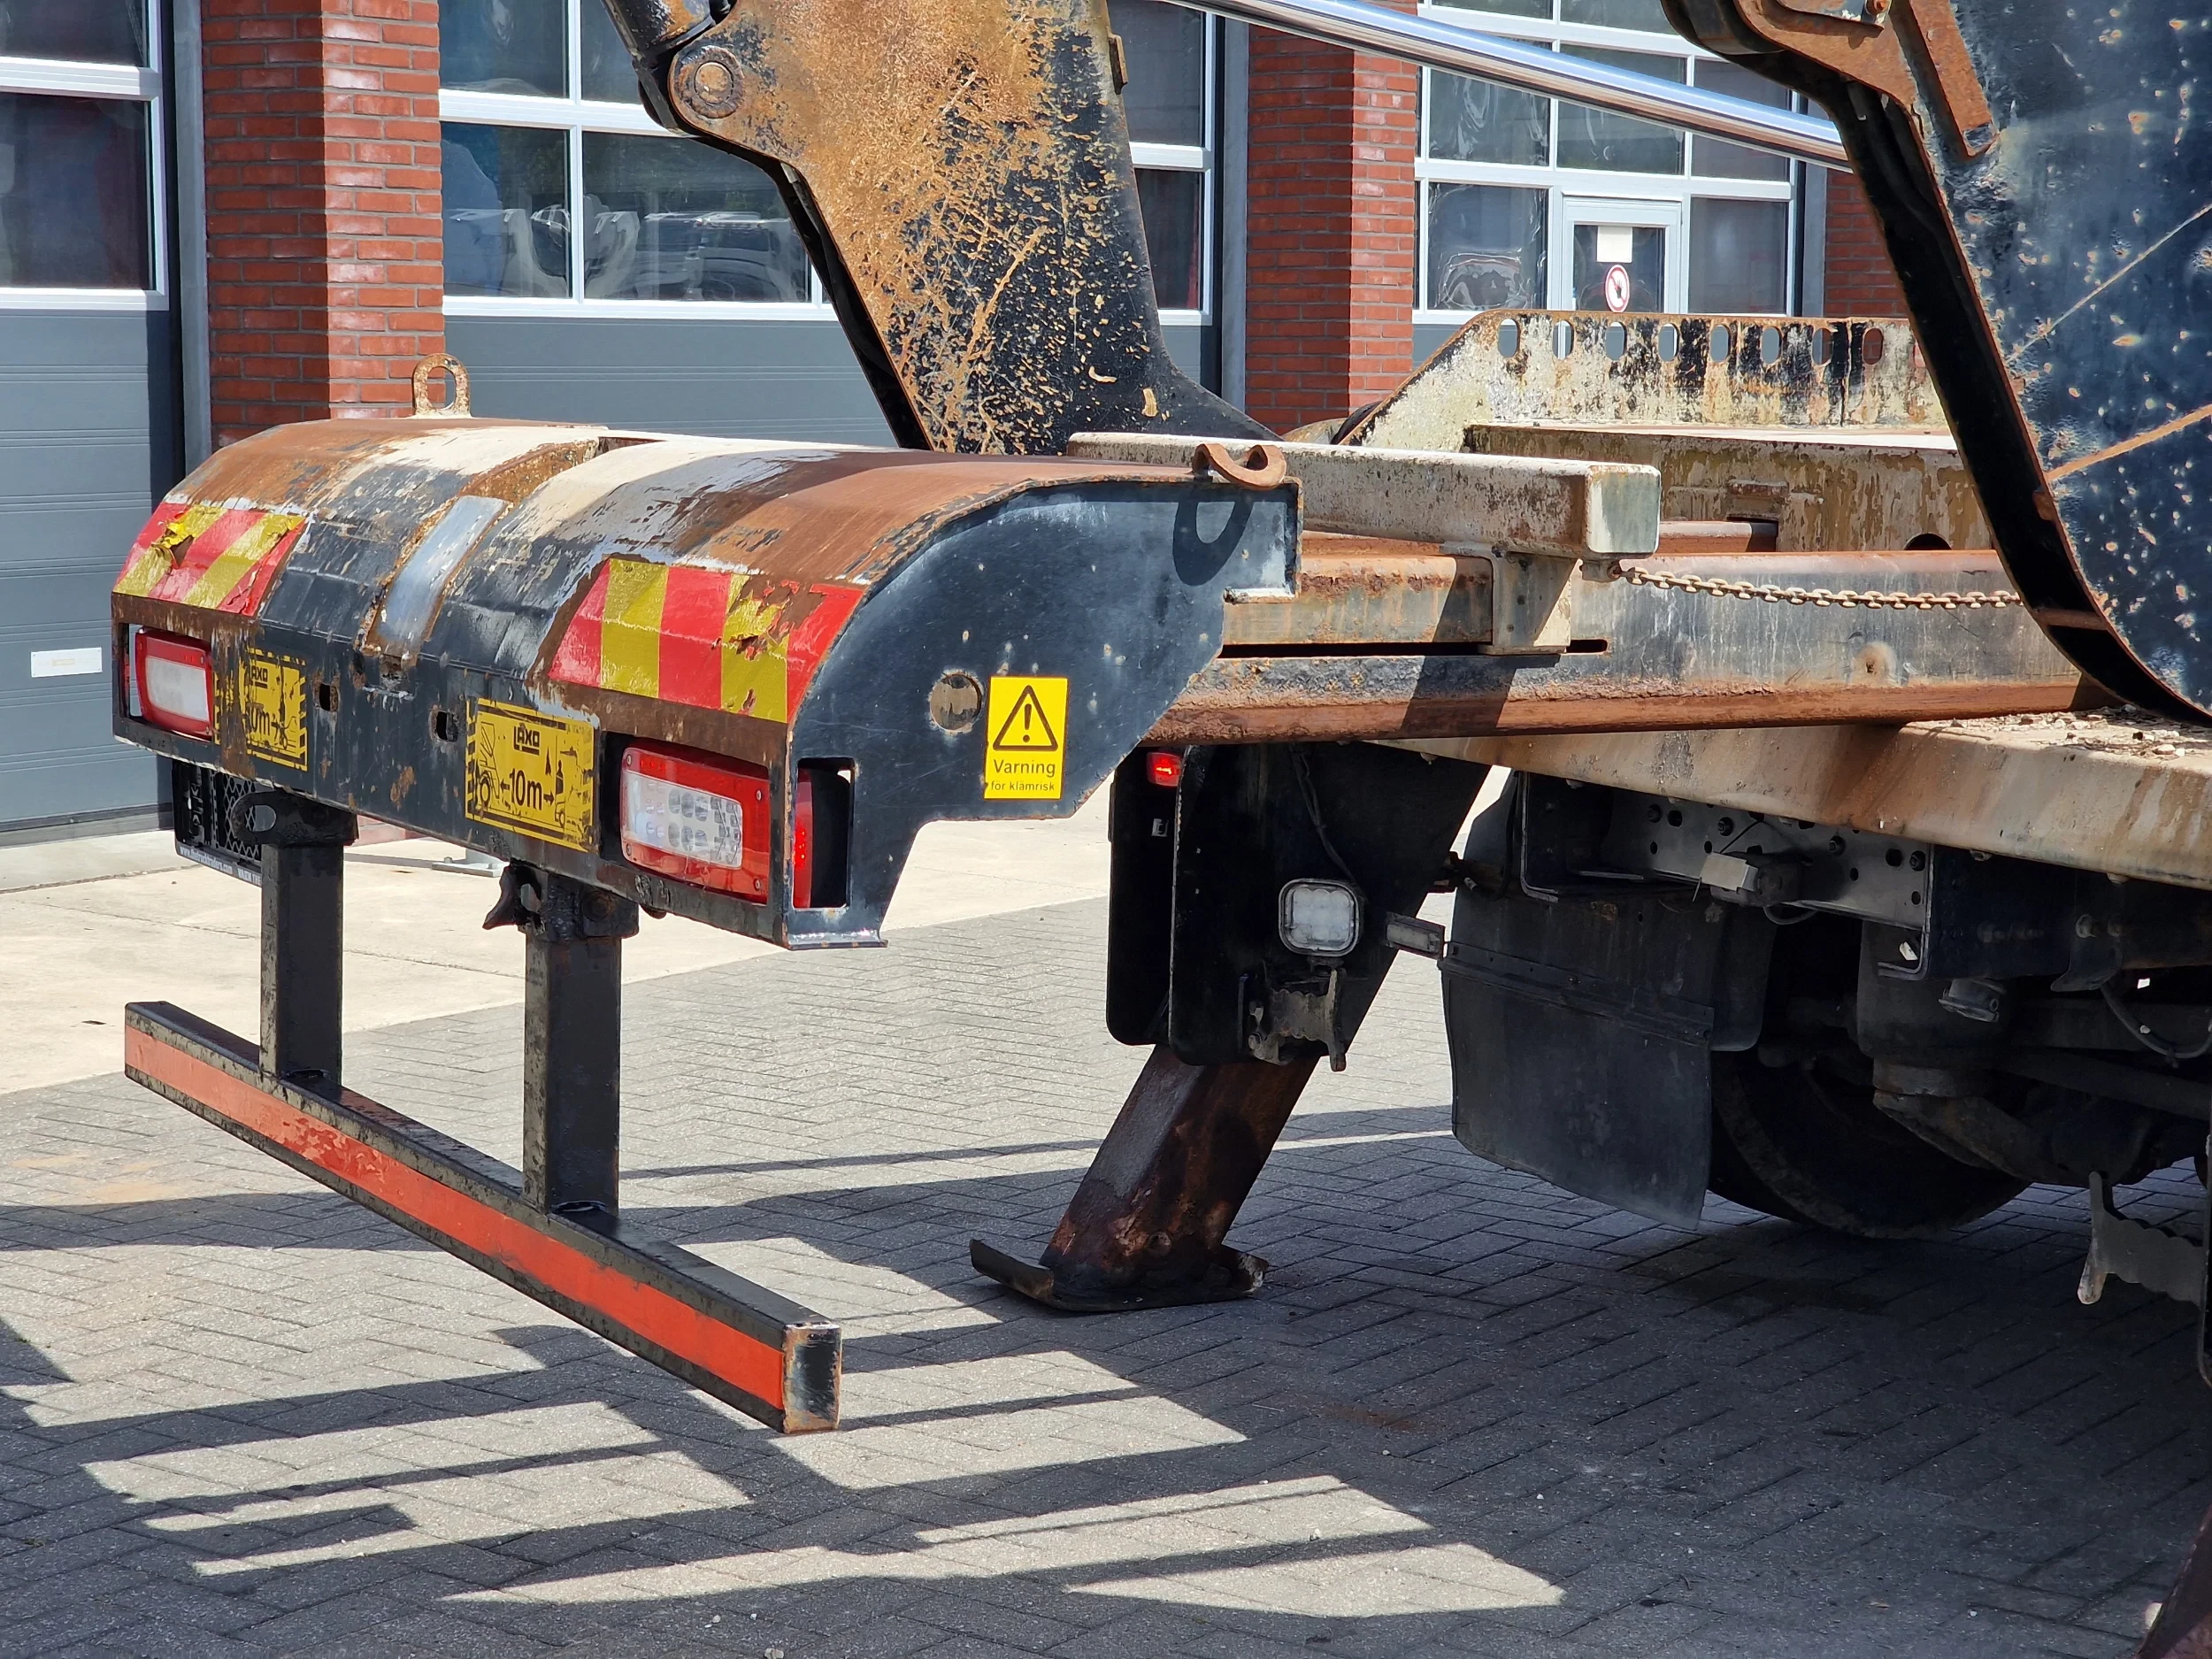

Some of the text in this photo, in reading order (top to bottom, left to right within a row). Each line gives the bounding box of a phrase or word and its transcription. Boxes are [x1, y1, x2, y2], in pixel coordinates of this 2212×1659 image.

[513, 723, 541, 756] LAXO
[994, 759, 1056, 778] Varning
[509, 768, 542, 810] 10m
[991, 780, 1055, 791] för klämrisk
